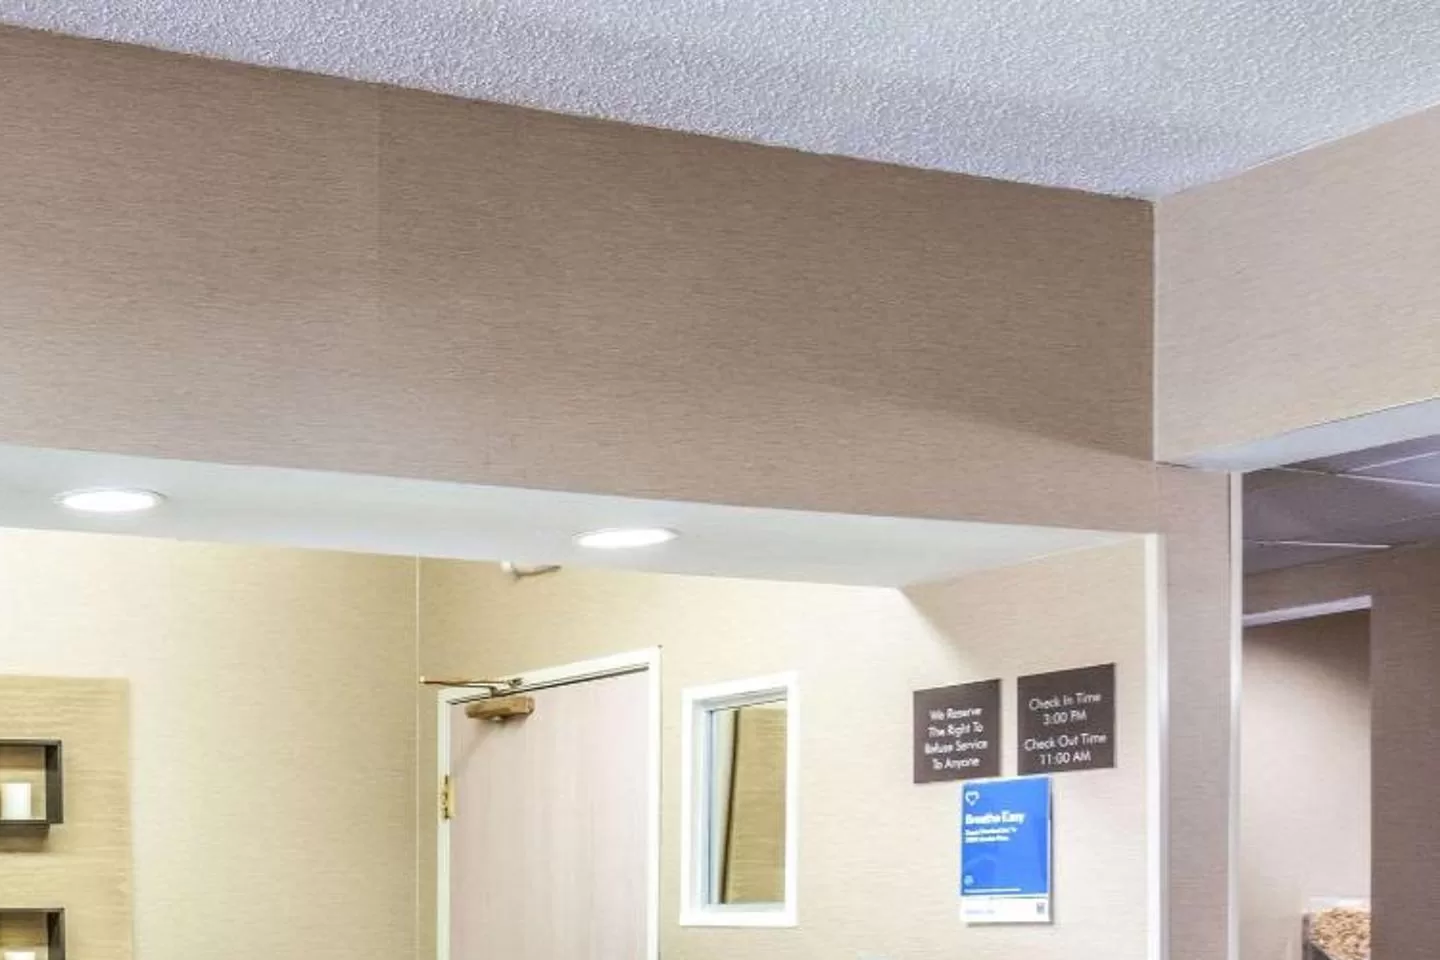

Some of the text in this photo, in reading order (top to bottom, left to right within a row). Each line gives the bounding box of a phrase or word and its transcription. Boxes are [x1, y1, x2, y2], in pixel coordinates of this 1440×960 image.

[1028, 692, 1102, 711] Check In Time
[929, 707, 983, 720] We Reserve
[1042, 709, 1088, 726] 3:00 PM
[927, 721, 984, 738] The Right To
[924, 740, 989, 755] Refuse Service
[1024, 732, 1107, 751] Check Out Time
[932, 757, 980, 770] To Anyone
[1039, 750, 1092, 765] 11:00 AM
